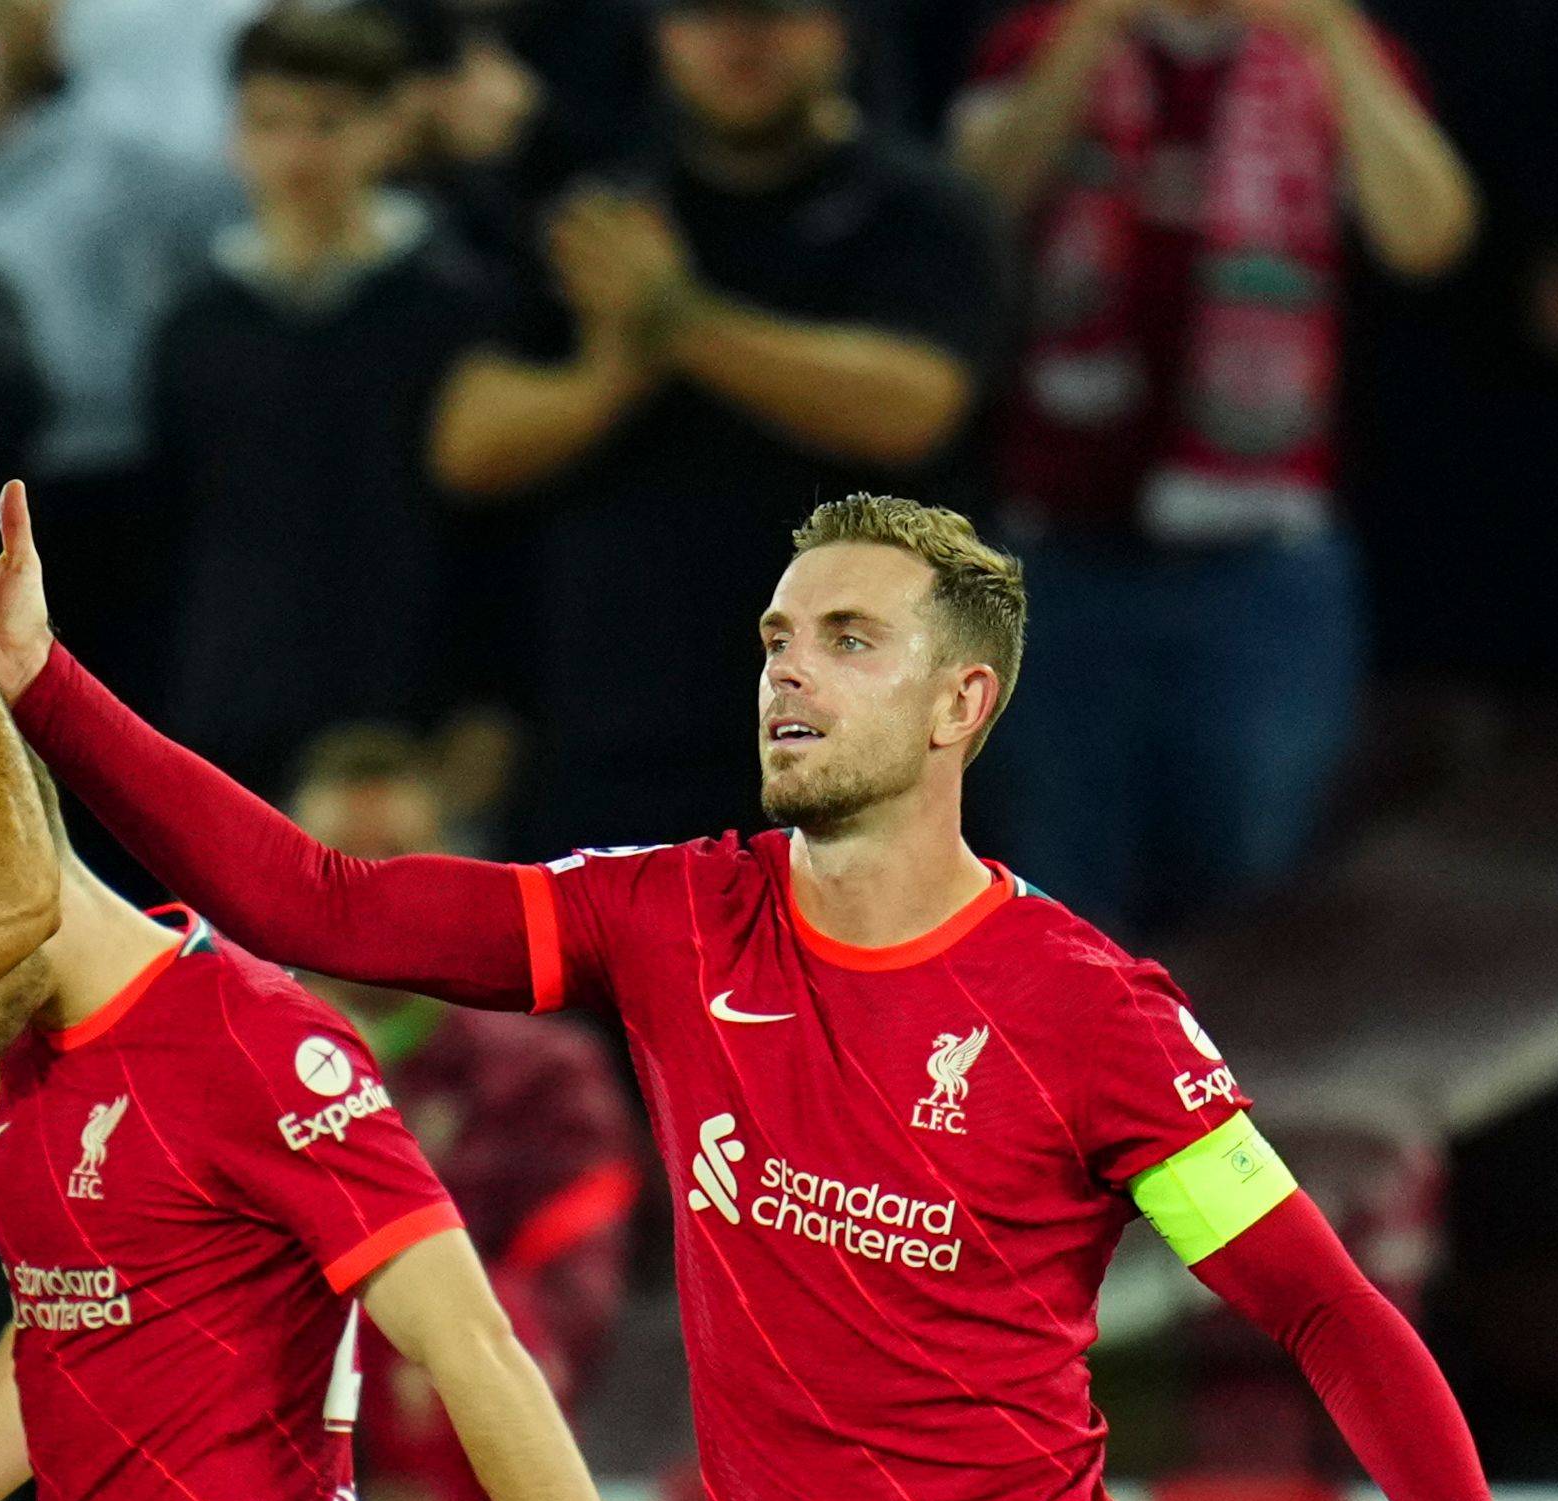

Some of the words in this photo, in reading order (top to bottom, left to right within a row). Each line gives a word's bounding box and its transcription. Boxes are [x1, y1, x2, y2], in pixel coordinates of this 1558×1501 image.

[909, 1105, 967, 1135] L.F.C.
[1173, 1065, 1237, 1112] Exp
[760, 1157, 956, 1236] standard
[751, 1193, 962, 1272] chartered
